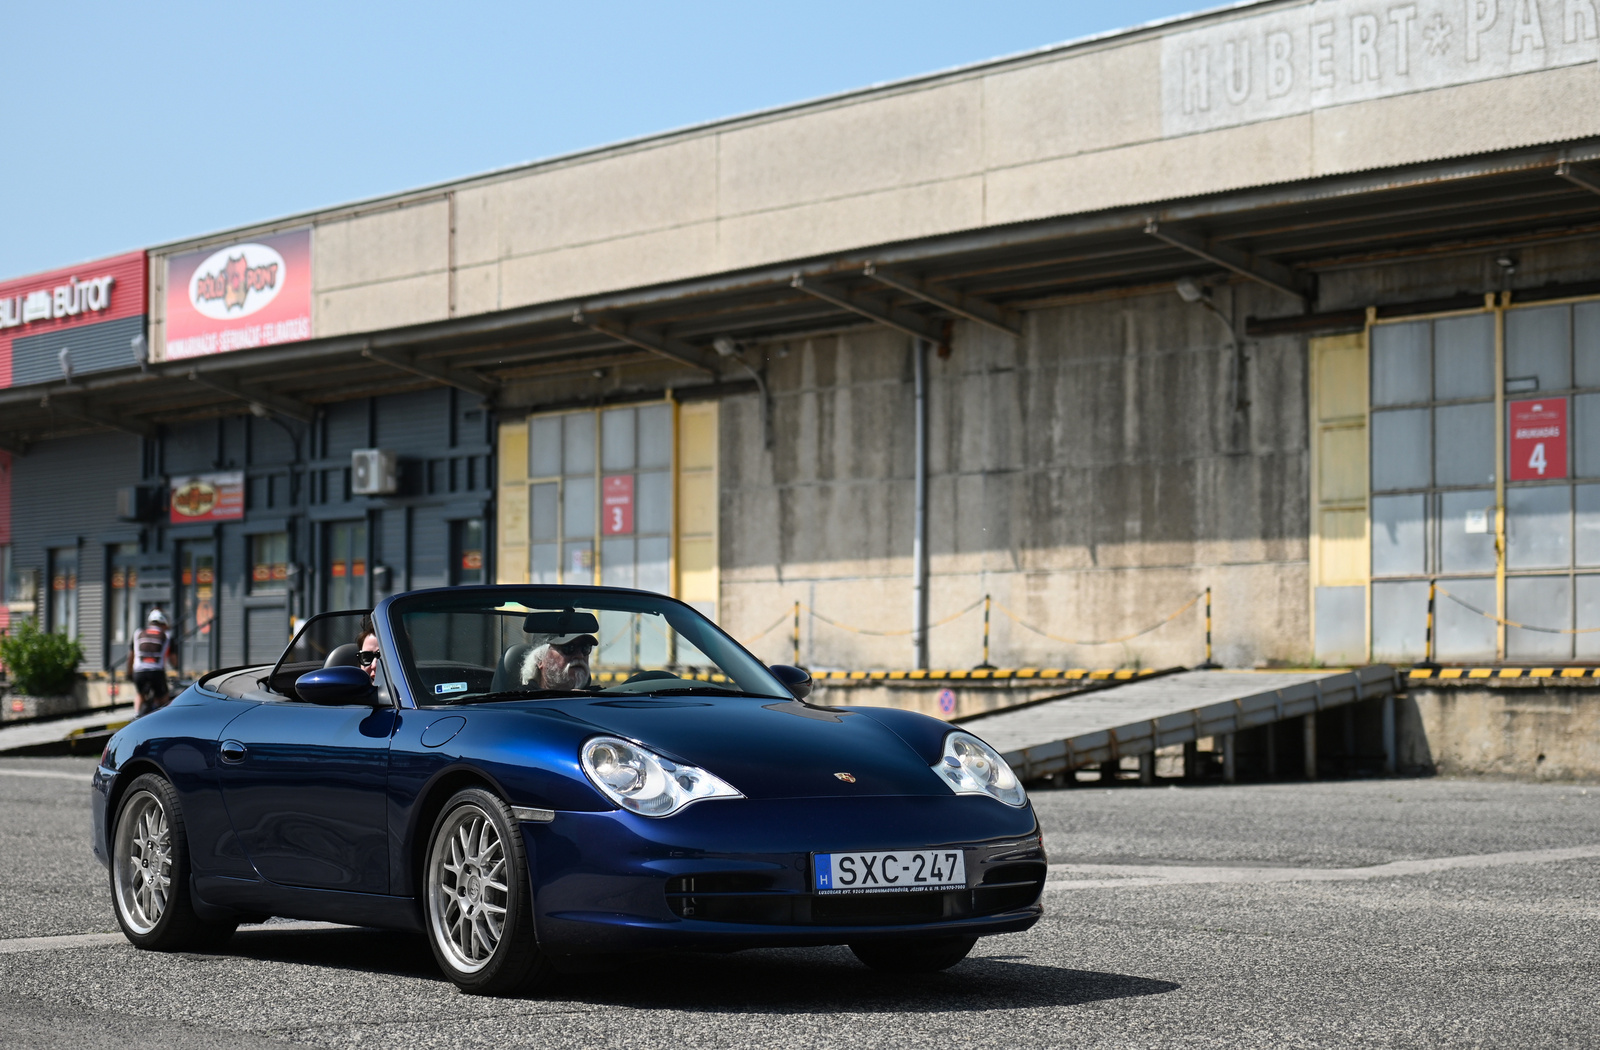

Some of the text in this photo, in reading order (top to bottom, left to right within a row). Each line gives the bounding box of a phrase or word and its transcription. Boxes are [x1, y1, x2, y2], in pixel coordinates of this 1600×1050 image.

[1181, 5, 1418, 115] HUBERT
[246, 262, 278, 292] PONT
[53, 274, 114, 319] BÚTOR
[1528, 443, 1547, 475] 4
[611, 506, 624, 533] 3
[820, 874, 829, 886] H
[838, 853, 958, 886] SXC-247
